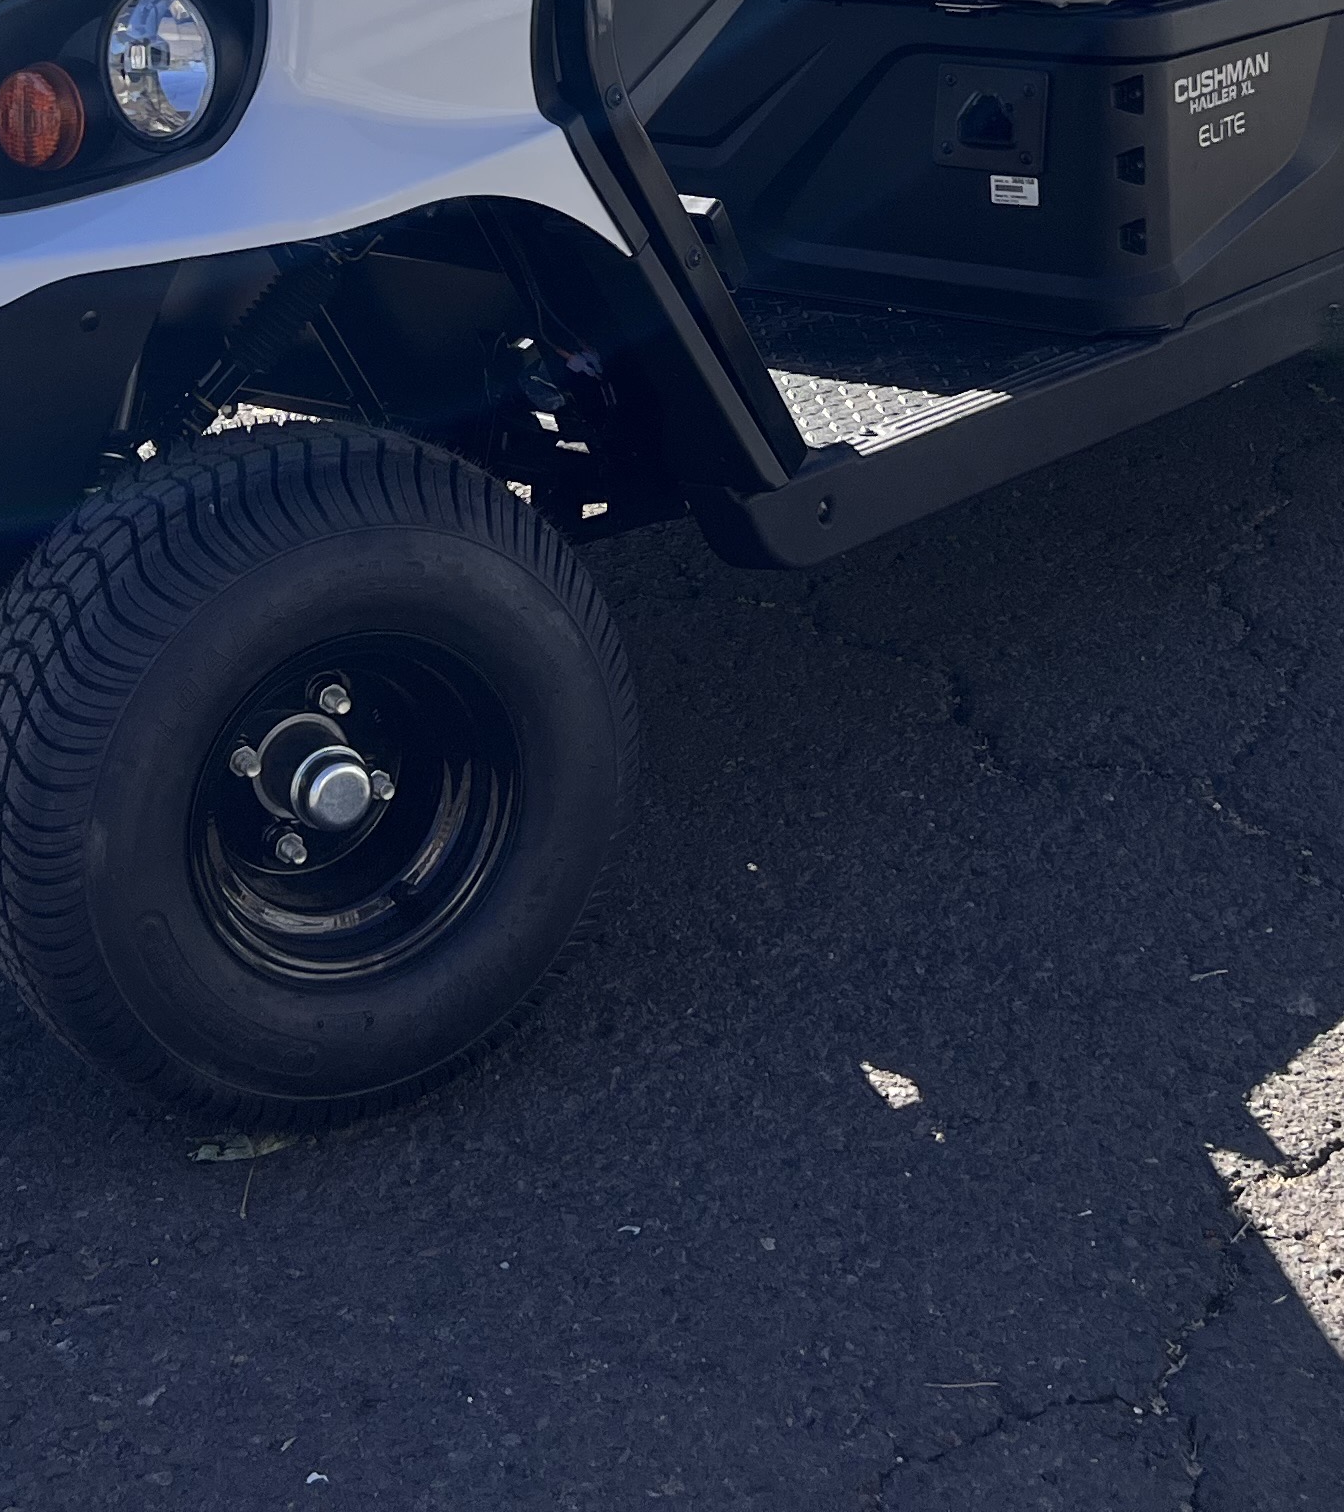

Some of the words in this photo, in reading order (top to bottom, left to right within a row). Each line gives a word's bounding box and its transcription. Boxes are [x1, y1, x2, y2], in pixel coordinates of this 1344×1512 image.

[1174, 51, 1269, 103] CUSHMAN
[1189, 85, 1237, 115] HAULER
[1241, 80, 1255, 98] XL
